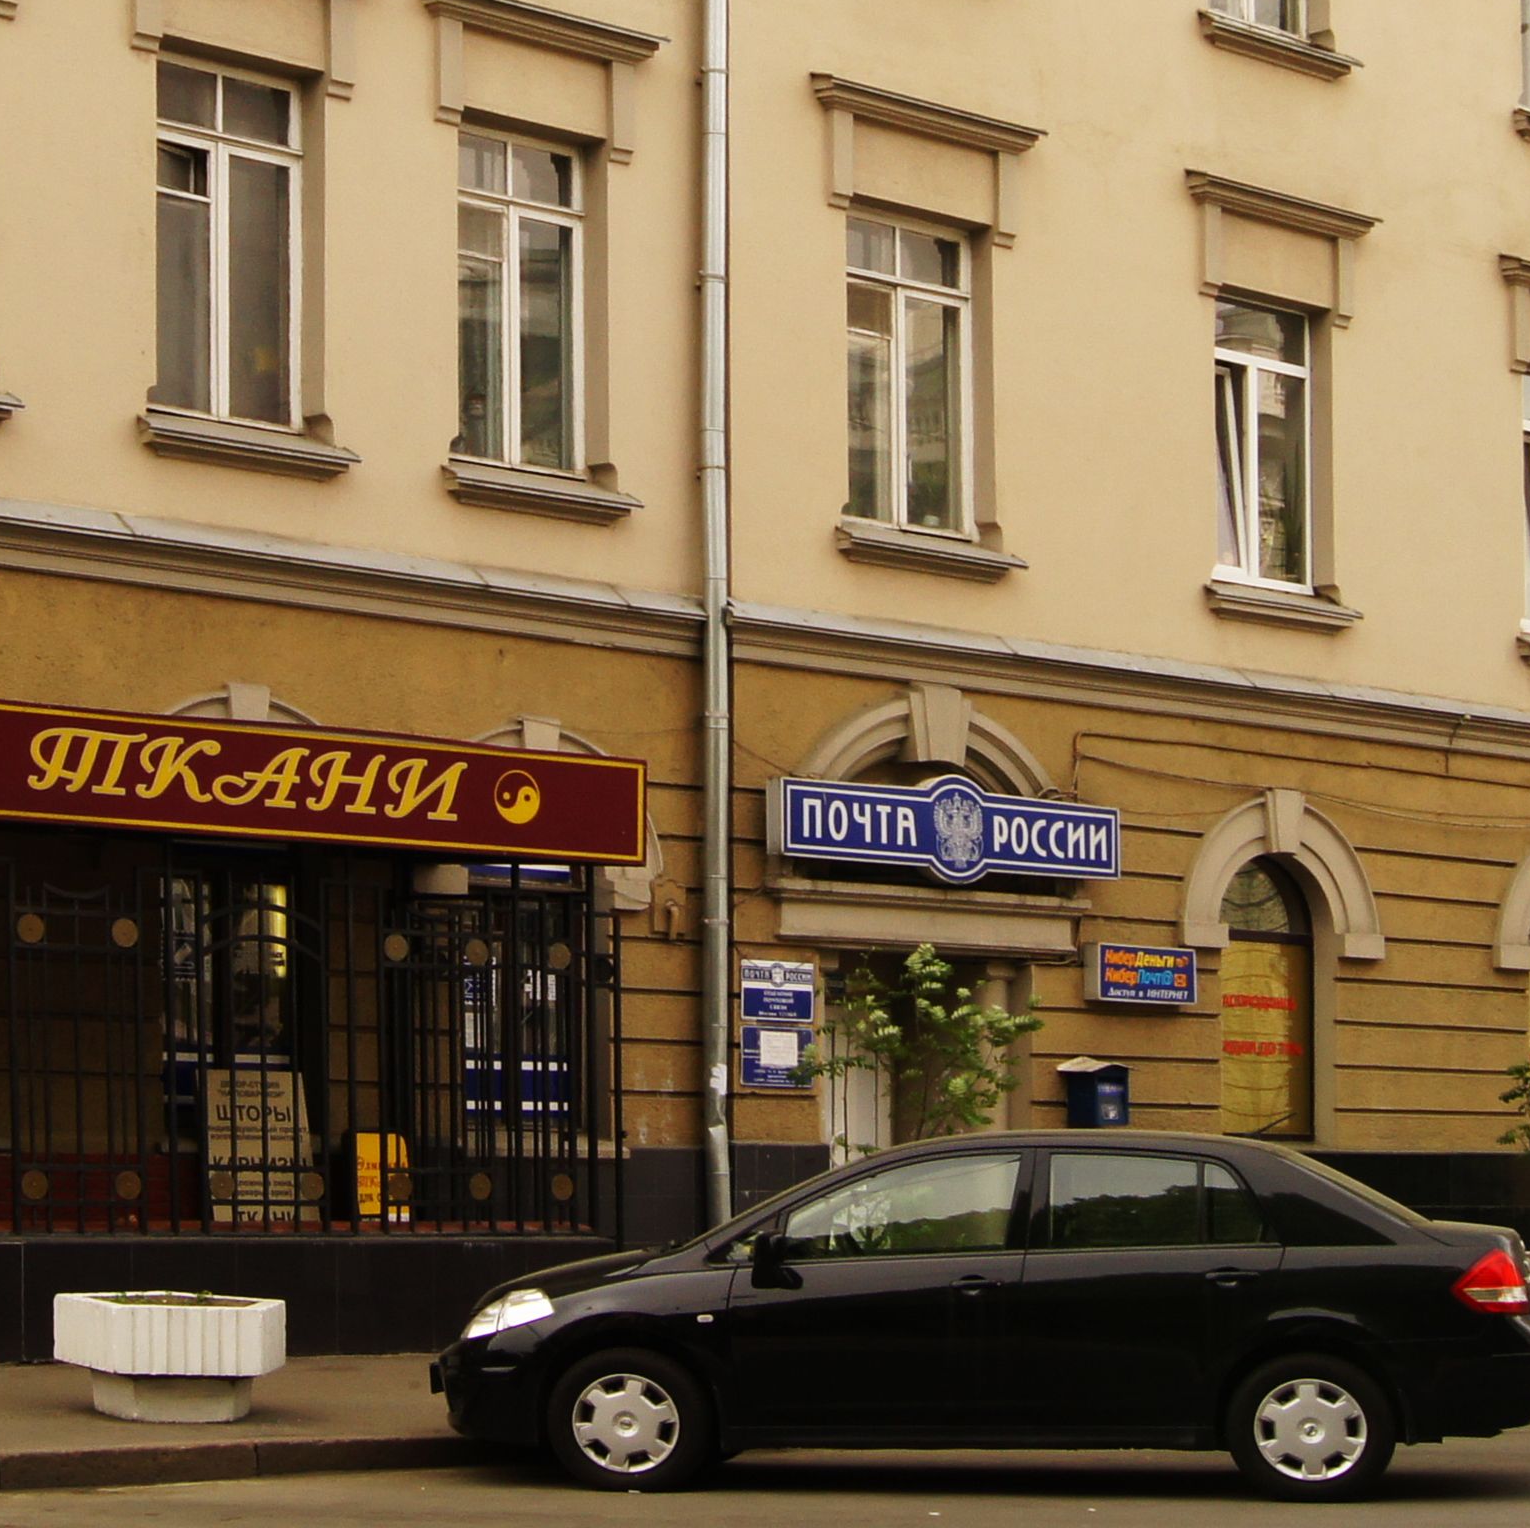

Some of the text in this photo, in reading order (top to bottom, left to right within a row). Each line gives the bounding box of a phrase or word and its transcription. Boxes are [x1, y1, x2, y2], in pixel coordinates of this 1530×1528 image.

[27, 727, 468, 822] ТКАНИ
[802, 797, 1108, 861] ПОЧТА РОССИИ
